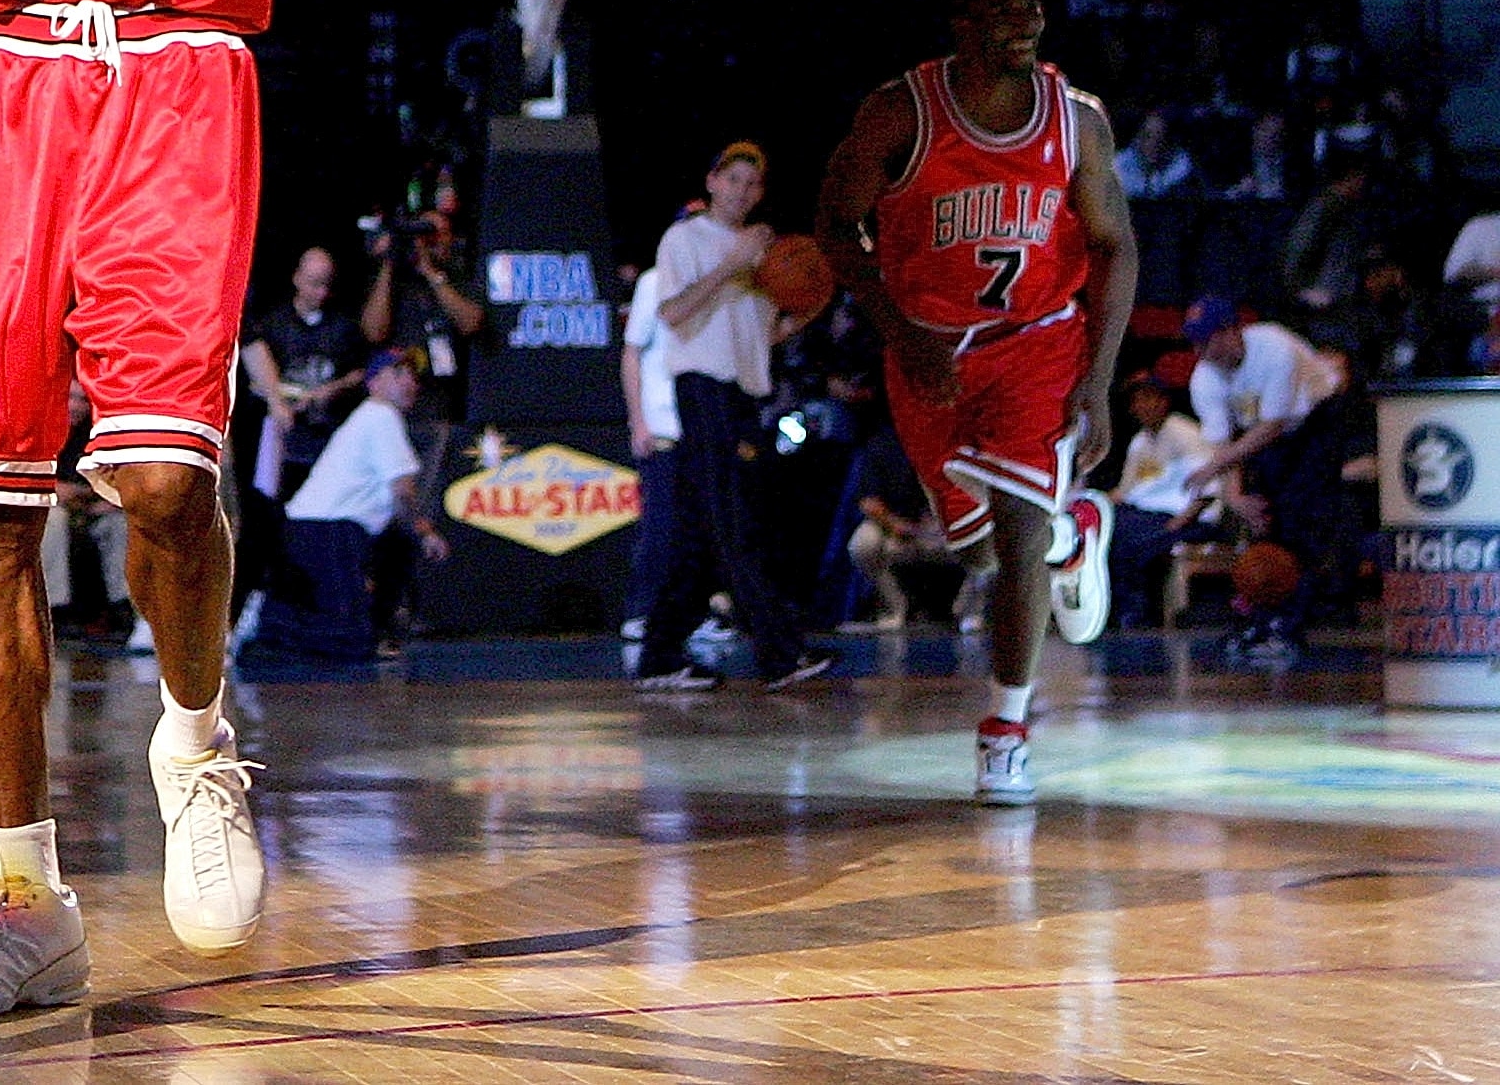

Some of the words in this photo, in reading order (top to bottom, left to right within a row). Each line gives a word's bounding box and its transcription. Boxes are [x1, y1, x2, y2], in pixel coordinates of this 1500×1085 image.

[931, 181, 1063, 251] BULLS
[512, 252, 597, 302] NBA
[974, 244, 1028, 312] 7
